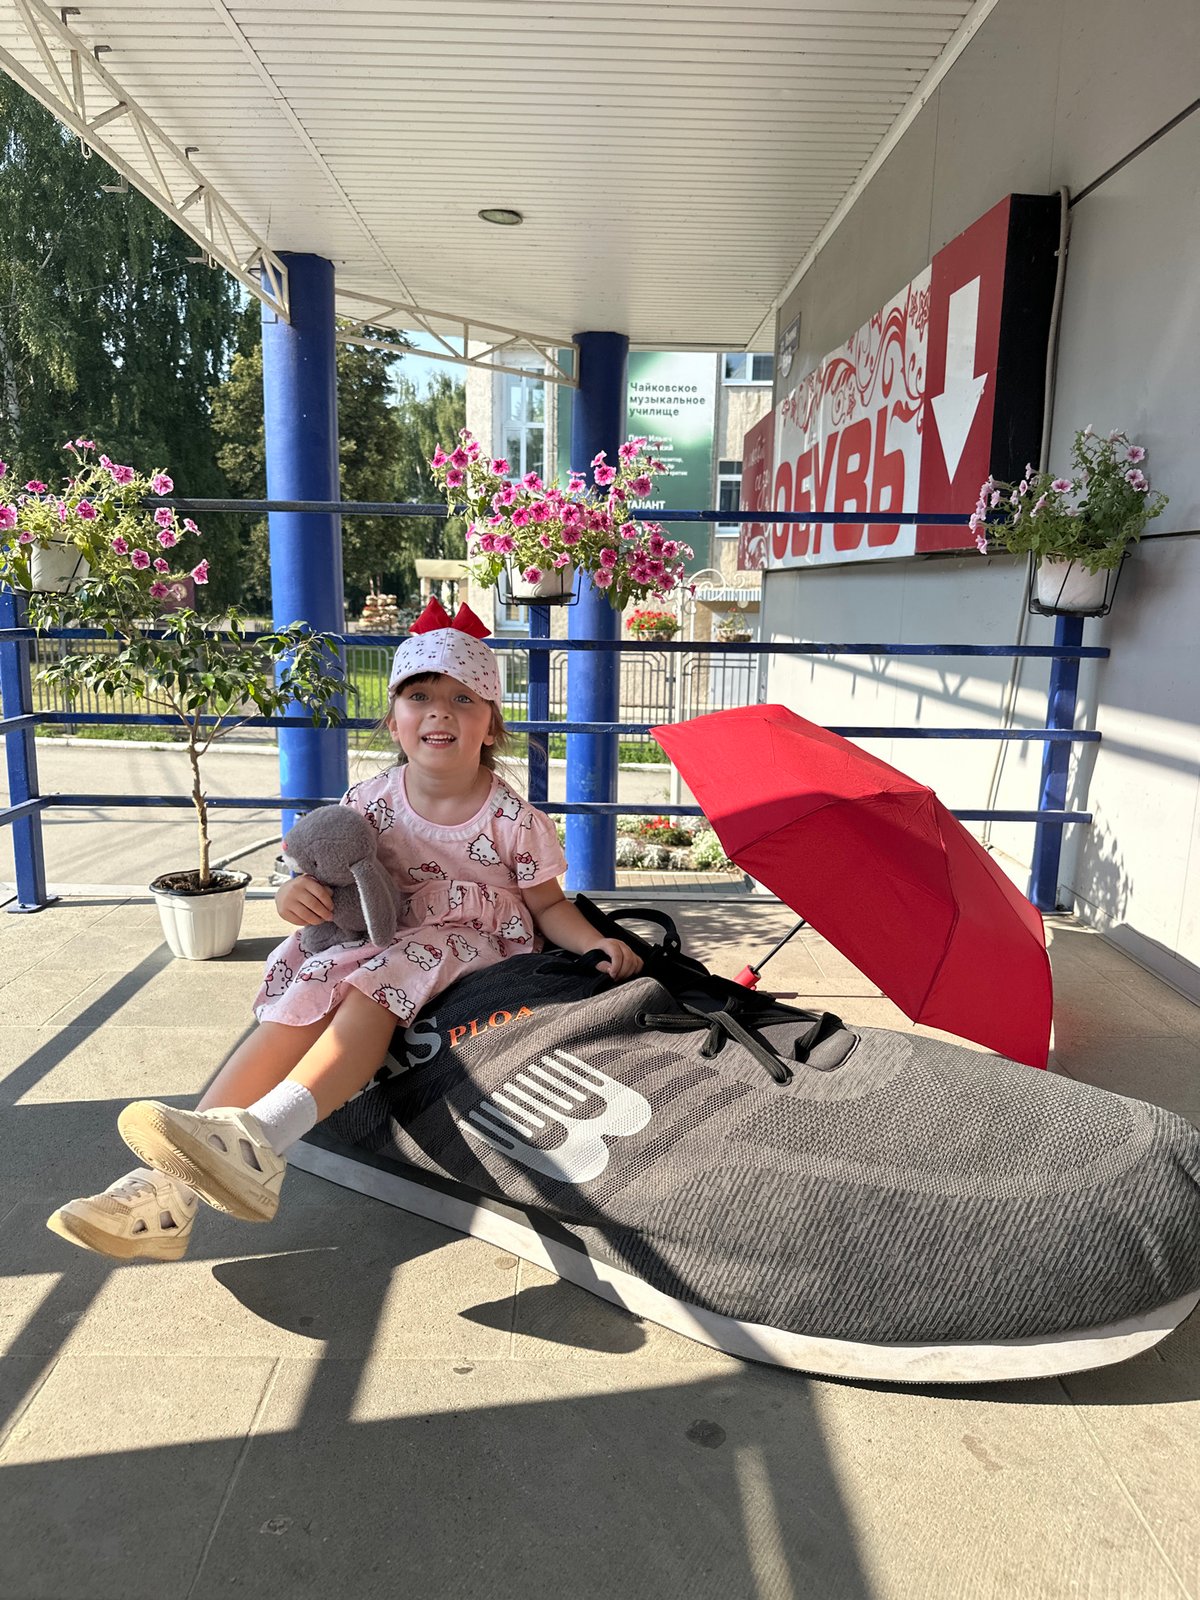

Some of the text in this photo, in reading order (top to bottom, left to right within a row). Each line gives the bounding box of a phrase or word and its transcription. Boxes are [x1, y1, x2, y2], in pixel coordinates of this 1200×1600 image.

[630, 382, 698, 392] Чайковское
[629, 396, 706, 405] музыкальное
[629, 408, 680, 417] училище
[772, 404, 906, 560] ОБУВЬ
